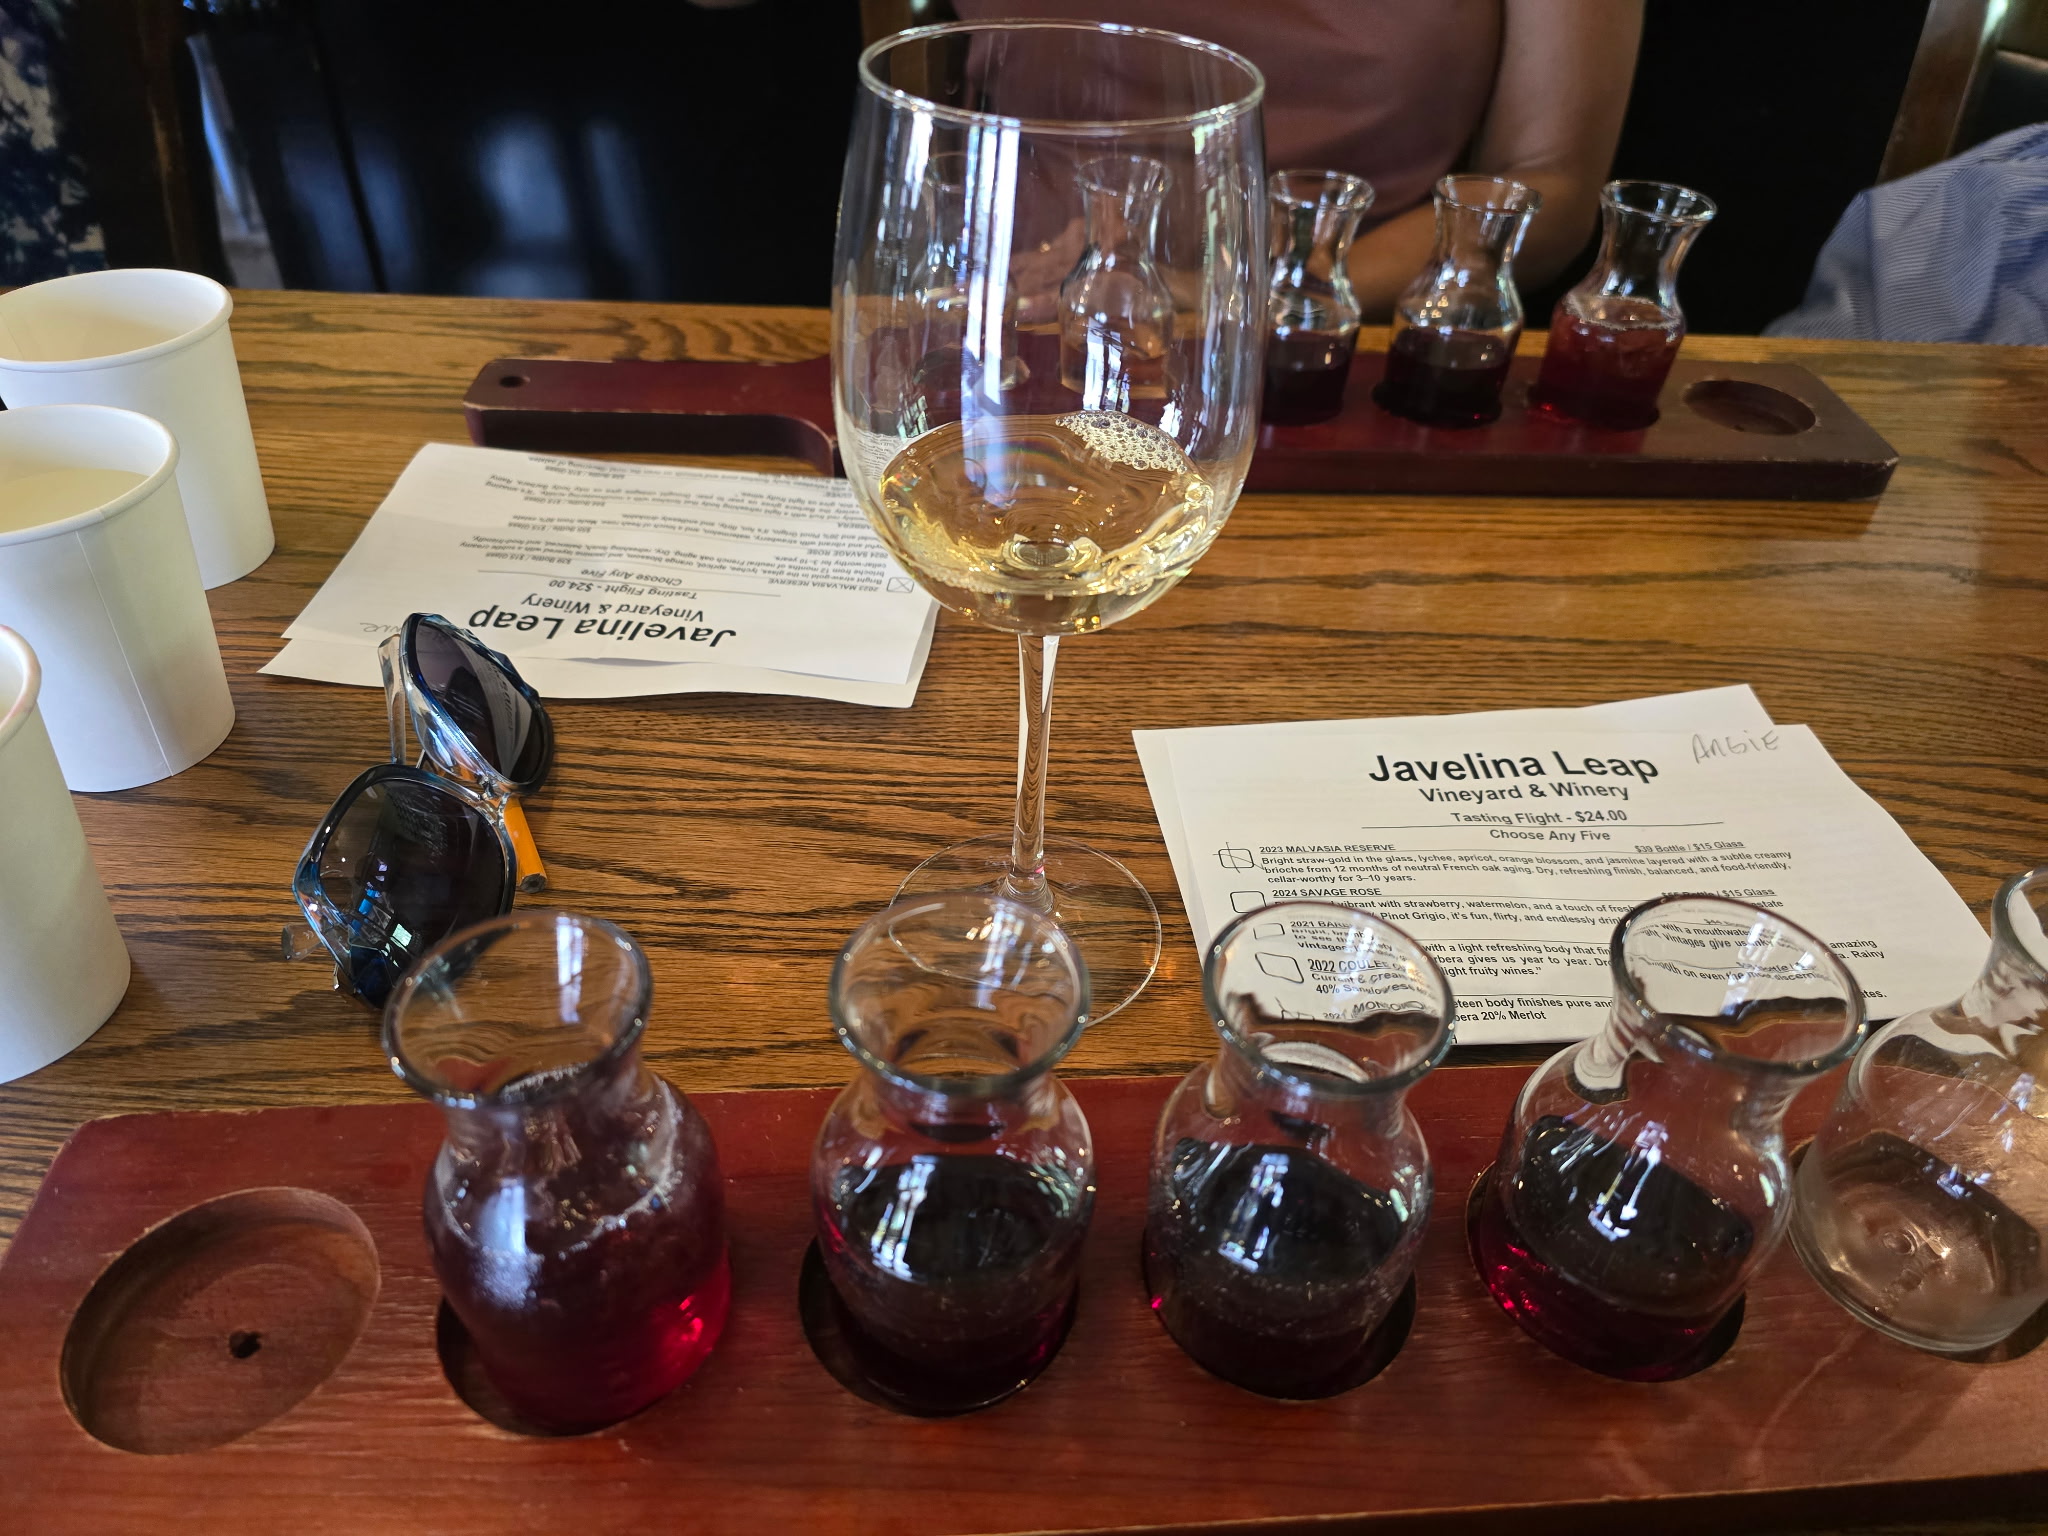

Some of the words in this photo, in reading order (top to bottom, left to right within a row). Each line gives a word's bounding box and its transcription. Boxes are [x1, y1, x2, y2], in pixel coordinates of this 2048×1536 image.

[833, 550, 868, 558] SAVAGE
[788, 564, 818, 572] months
[834, 560, 886, 568] cellar-worthy
[581, 568, 606, 577] Five
[611, 570, 633, 580] Any
[760, 568, 784, 577] glass,
[810, 573, 855, 582] straw-gold
[854, 568, 884, 576] brioche
[636, 574, 683, 586] Choose
[768, 578, 810, 587] RESERVE
[811, 581, 857, 590] MALVASIA
[857, 576, 882, 584] Bright
[549, 580, 594, 592] $24.00
[604, 584, 644, 596] Flight
[648, 588, 698, 600] Tasting
[522, 594, 591, 614] Winery
[598, 605, 612, 614] &
[614, 604, 704, 622] Vineyard
[469, 606, 564, 639] Leap
[574, 619, 736, 647] Javelina
[1368, 751, 1546, 782] Javelina
[1554, 750, 1659, 783] Leap
[1419, 783, 1523, 804] Vineyard
[1529, 783, 1546, 798] &
[1549, 782, 1629, 801] Winery
[1451, 812, 1511, 825] Tasting
[1515, 811, 1563, 825] Flight
[1575, 809, 1628, 823] $24.00
[1489, 829, 1545, 840] Choose
[1548, 830, 1576, 843] Any
[1580, 830, 1611, 841] Five
[1344, 844, 1396, 852] RESERVE
[1634, 844, 1653, 854] $39
[1656, 844, 1685, 852] Bottle
[1693, 842, 1712, 852] $15
[1714, 840, 1744, 849] Glass
[1262, 857, 1294, 866] Bright
[1296, 856, 1350, 866] straw-gold
[1353, 855, 1362, 863] in
[1365, 855, 1382, 863] the
[1385, 855, 1417, 866] glass,
[1418, 854, 1455, 866] lychee,
[1457, 854, 1496, 866] apricot,
[1499, 857, 1533, 867] orange
[1535, 856, 1580, 867] blossom,
[1584, 856, 1604, 866] and
[1605, 856, 1645, 866] jasmine
[1647, 856, 1684, 867] layered
[1686, 855, 1709, 864] with
[1720, 852, 1751, 862] subtle
[1754, 850, 1792, 860] creamy
[1266, 864, 1303, 874] brioche
[1306, 865, 1331, 873] from
[1349, 864, 1388, 873] months
[1392, 864, 1402, 872] of
[1404, 864, 1442, 872] neutral
[1444, 864, 1479, 872] French
[1482, 863, 1500, 872] oak
[1502, 864, 1534, 874] aging.
[1536, 866, 1554, 876] Dry,
[1559, 866, 1612, 876] refreshing
[1614, 866, 1646, 876] finish,
[1648, 866, 1697, 874] balanced,
[1700, 864, 1720, 872] and
[1720, 862, 1792, 872] food-friendly,
[1268, 875, 1336, 884] cellar-worthy
[1338, 874, 1353, 882] for
[1383, 875, 1416, 884] years.
[1272, 889, 1298, 897] 2024
[1300, 888, 1347, 896] SAVAGE
[1350, 888, 1382, 896] ROSE
[1722, 889, 1742, 898] $15
[1744, 888, 1774, 896] Glass
[1378, 900, 1402, 908] with
[1404, 900, 1464, 910] strawberry,
[1466, 901, 1531, 910] watermelon,
[1533, 902, 1552, 910] and
[1564, 904, 1594, 912] touch
[1596, 904, 1608, 912] of
[1608, 905, 1636, 913] fresh
[1380, 912, 1411, 920] Pinot
[1413, 912, 1449, 922] Grigio,
[1452, 912, 1468, 920] it's
[1470, 912, 1492, 922] fun,
[1493, 913, 1522, 922] flirty,
[1524, 914, 1544, 922] and
[1546, 916, 1596, 926] endlessly
[1662, 923, 1683, 934] with
[1830, 940, 1878, 948] amazing
[1423, 944, 1446, 952] with
[1458, 944, 1482, 954] light
[1486, 944, 1542, 954] refreshing
[1545, 944, 1571, 955] body
[1573, 946, 1596, 954] that
[1709, 940, 1731, 950] give
[1851, 950, 1884, 958] Rainy
[1308, 958, 1336, 972] 2022
[1468, 955, 1498, 964] gives
[1520, 958, 1544, 966] year
[1548, 956, 1560, 964] to
[1564, 958, 1592, 966] year.
[1441, 966, 1468, 977] light
[1469, 966, 1498, 976] fruity
[1316, 984, 1340, 994] 40%
[1487, 998, 1515, 1009] body
[1516, 998, 1563, 1008] finishes
[1566, 1000, 1591, 1009] pure
[1700, 972, 1724, 981] even
[1482, 1012, 1507, 1021] 20%
[1508, 1011, 1548, 1020] Merlot
